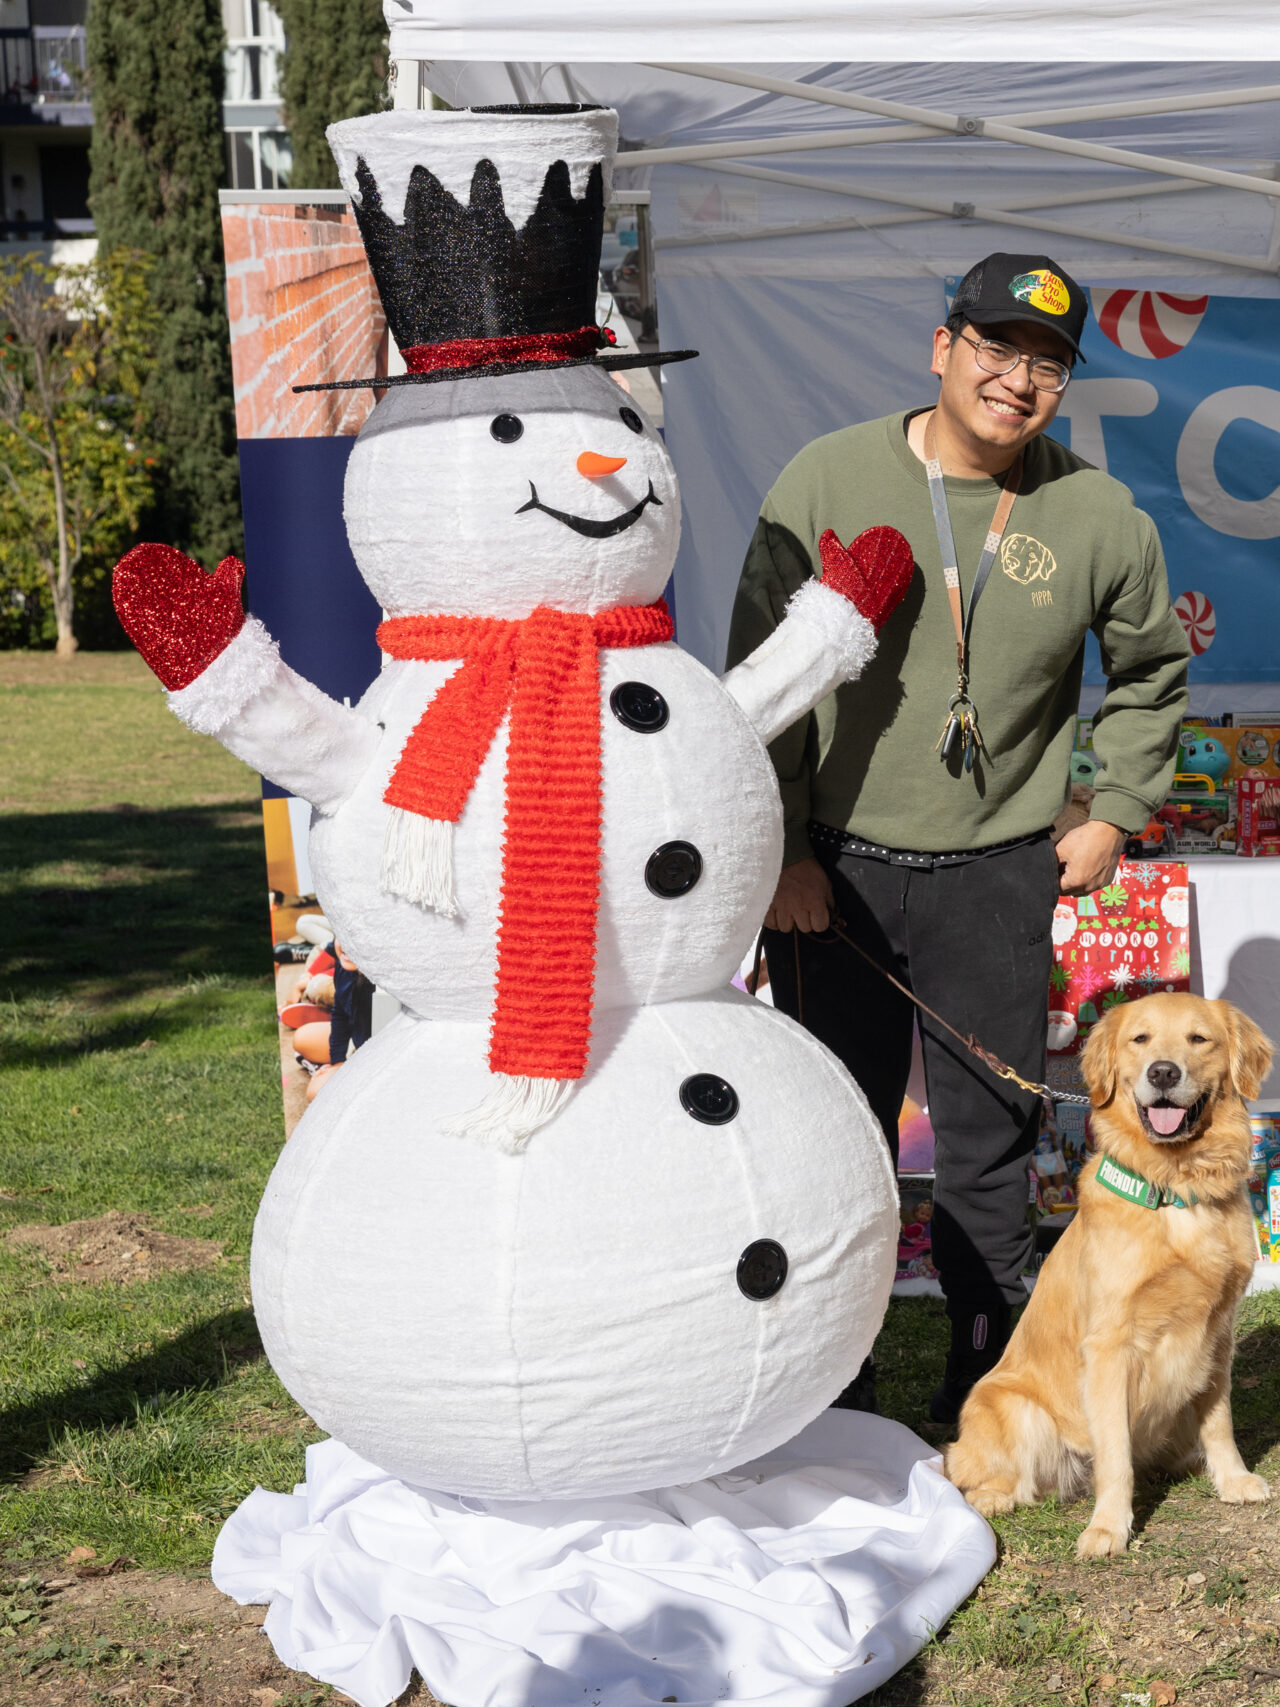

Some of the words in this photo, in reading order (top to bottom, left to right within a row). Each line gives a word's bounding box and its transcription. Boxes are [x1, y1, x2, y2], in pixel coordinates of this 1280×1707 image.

[1041, 283, 1060, 297] Pro
[1043, 270, 1065, 291] Bass
[1040, 292, 1066, 313] Shops
[1031, 589, 1054, 608] PIPPA
[1080, 932, 1157, 947] MERRY
[1055, 950, 1160, 963] HRISTMAS
[1100, 1160, 1145, 1198] FRIENDLY
